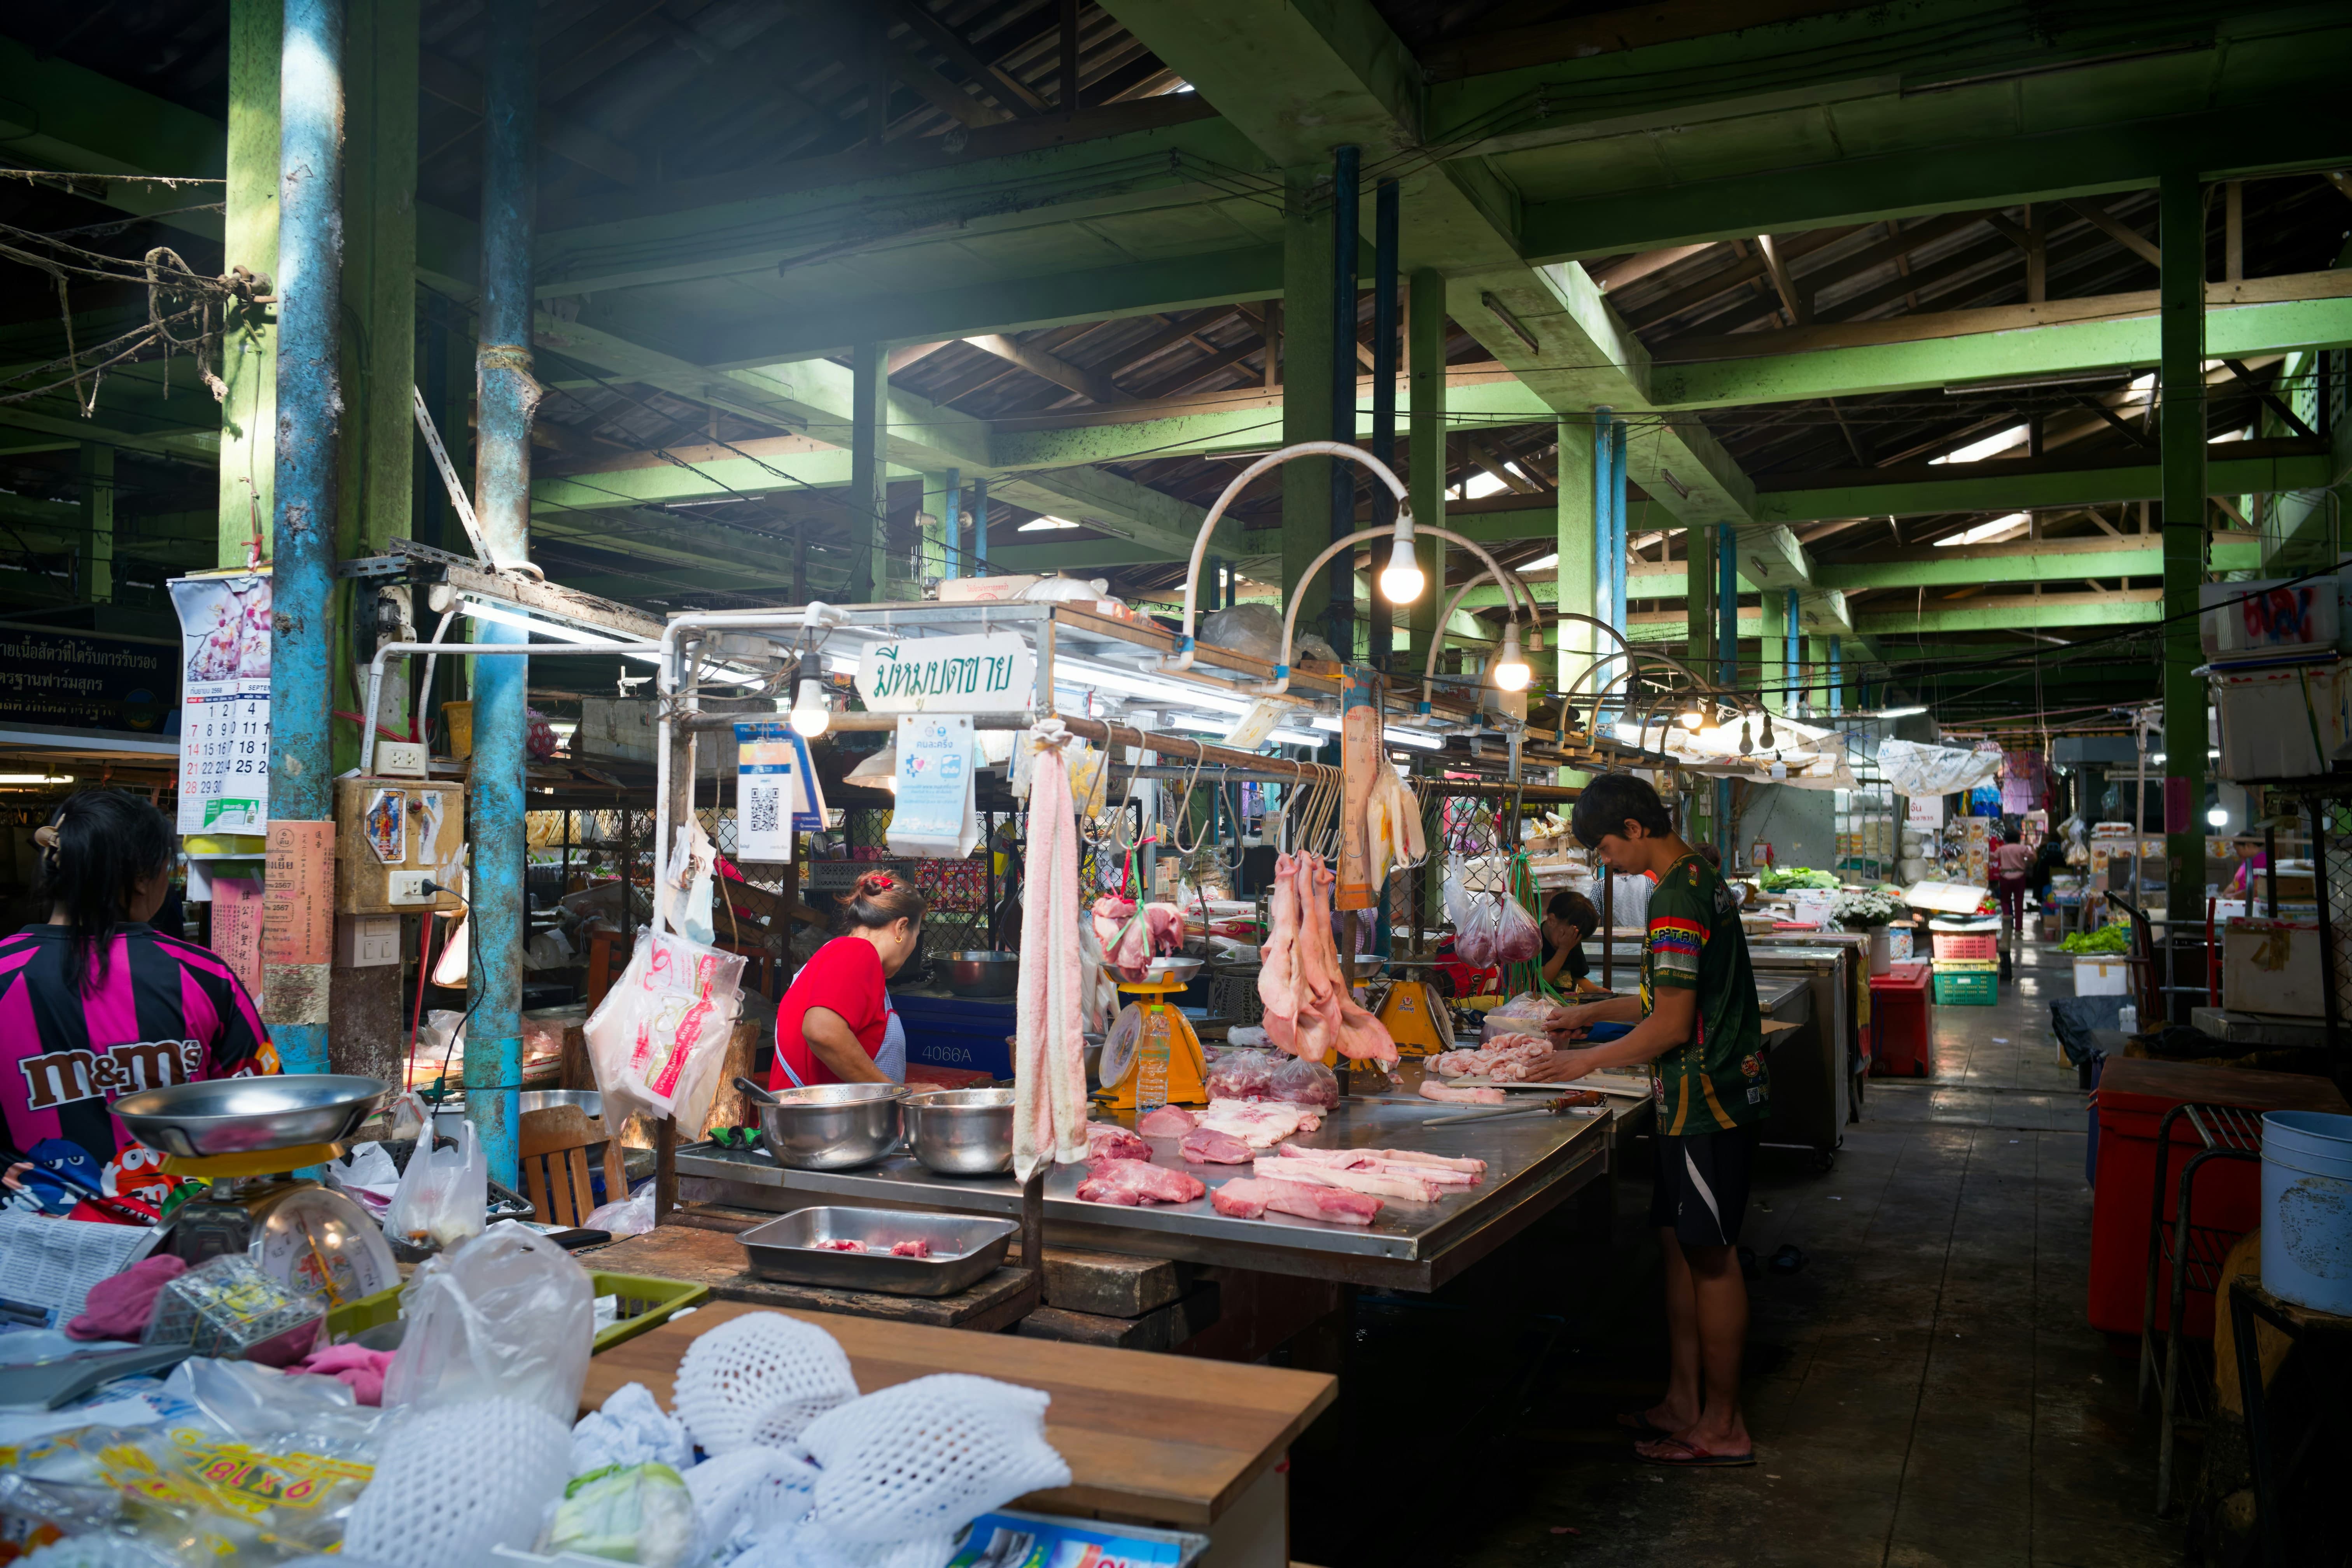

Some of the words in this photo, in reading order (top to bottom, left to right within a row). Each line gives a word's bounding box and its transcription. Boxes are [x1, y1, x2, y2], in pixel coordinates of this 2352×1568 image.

[874, 646, 1013, 712] มีหมูบดขาย
[209, 705, 214, 717] 1
[223, 704, 228, 717] 2
[248, 703, 255, 715] 4
[191, 724, 198, 737] 7
[207, 724, 213, 736] 8
[221, 723, 226, 735] 9
[243, 722, 256, 735] 11
[187, 744, 199, 756] 14
[204, 743, 214, 756] 15
[218, 743, 226, 755] 16
[240, 741, 254, 754] 18
[916, 737, 953, 749] คนละครึ่ง
[187, 763, 198, 775] 21
[202, 763, 213, 774] 22
[215, 762, 223, 774] 23
[236, 760, 252, 773] 25
[186, 782, 197, 794] 28
[201, 781, 211, 794] 29
[922, 1046, 971, 1062] 4066A
[205, 1461, 250, 1484] 18
[285, 1479, 312, 1499] 9
